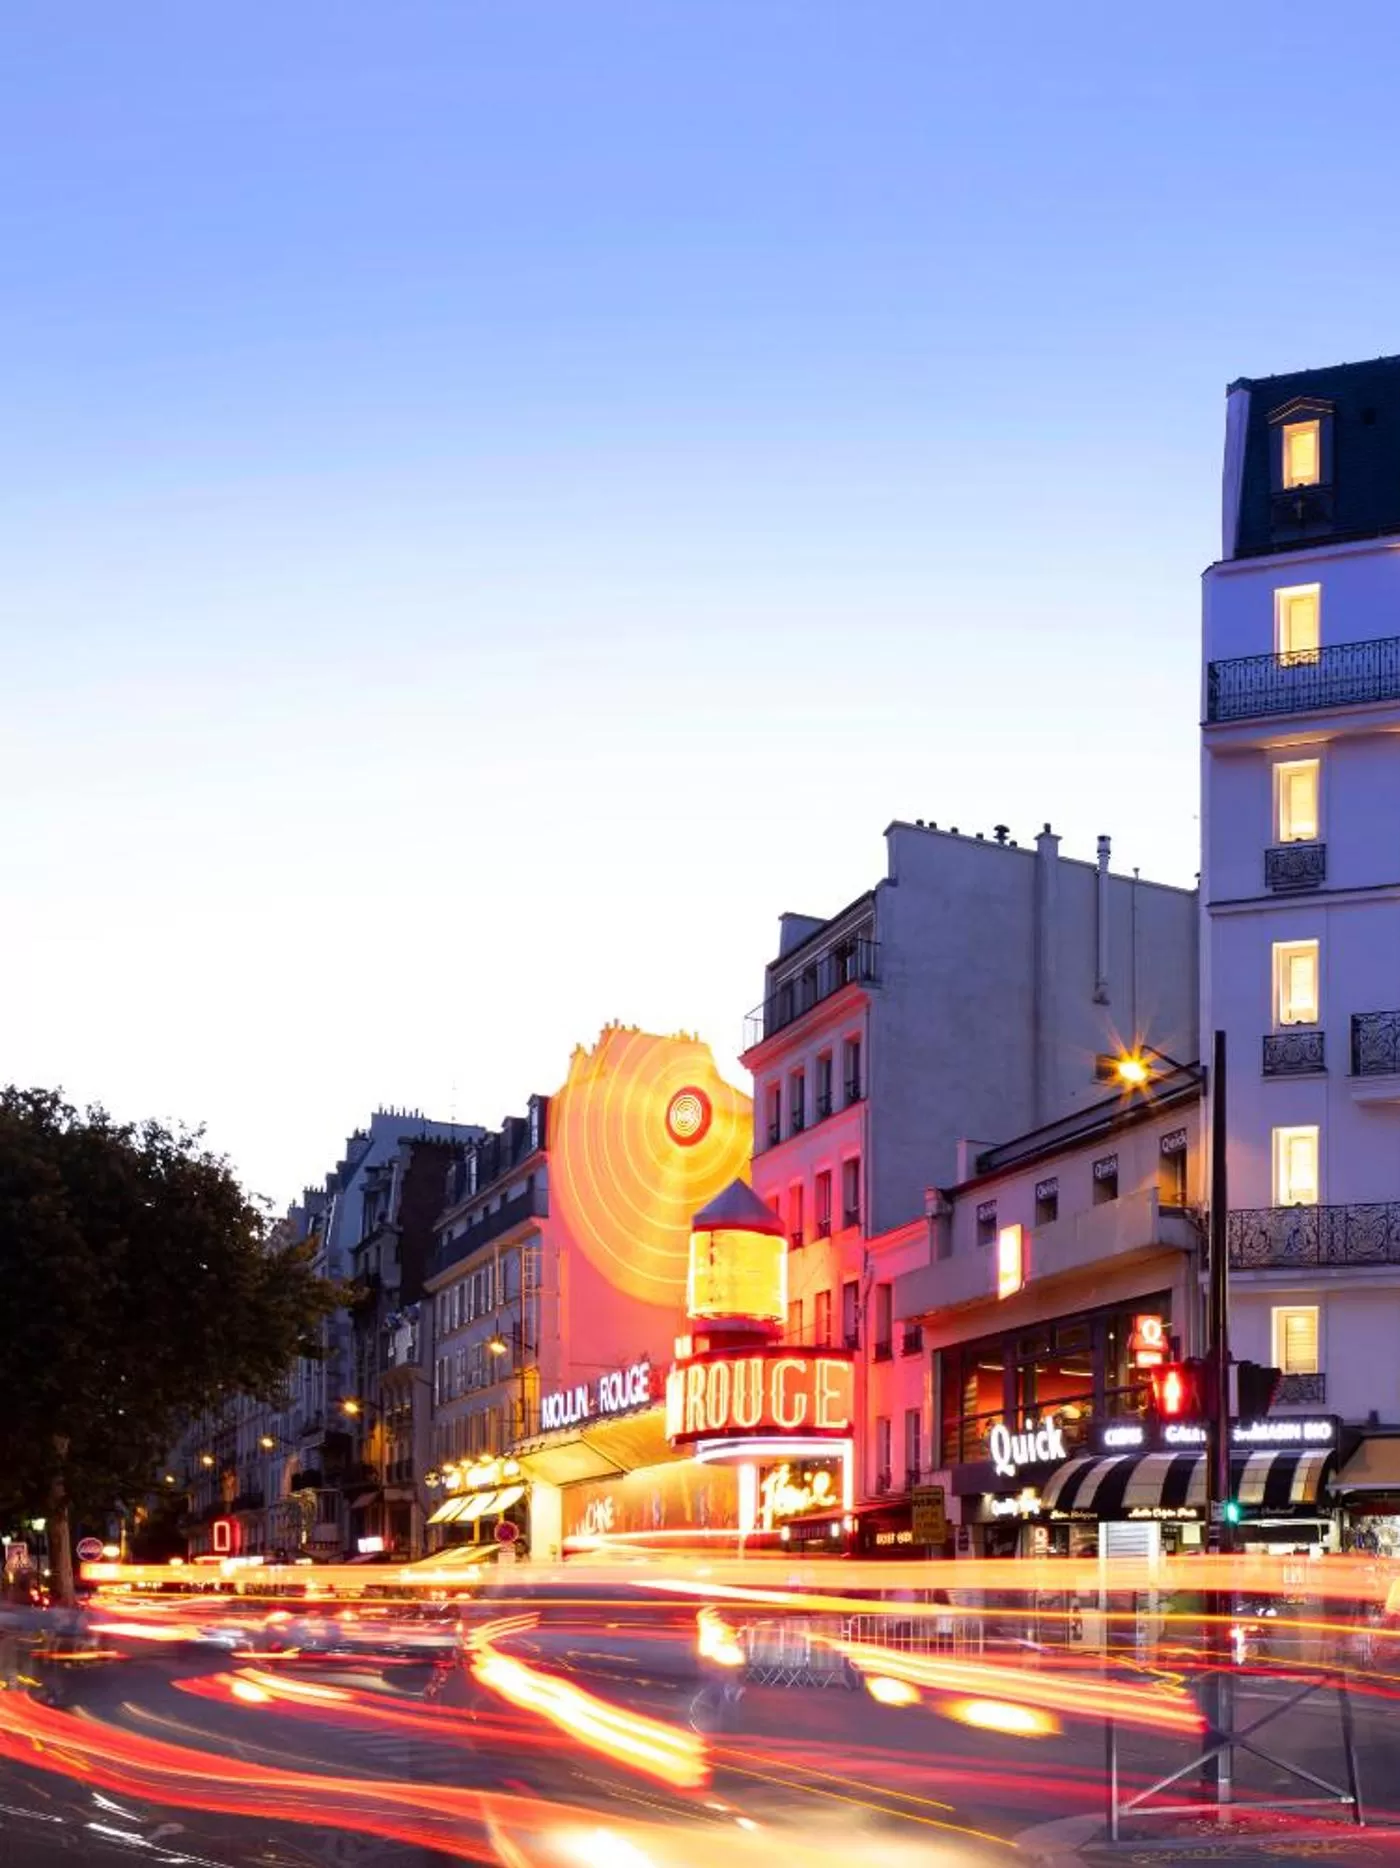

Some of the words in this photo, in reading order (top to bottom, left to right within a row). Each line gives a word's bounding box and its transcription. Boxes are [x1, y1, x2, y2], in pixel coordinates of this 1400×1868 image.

[1141, 1318, 1164, 1348] Q
[541, 1383, 590, 1430] MOULIN
[599, 1361, 650, 1413] ROUGE
[686, 1357, 850, 1430] ROUGE
[990, 1415, 1067, 1477] Quick
